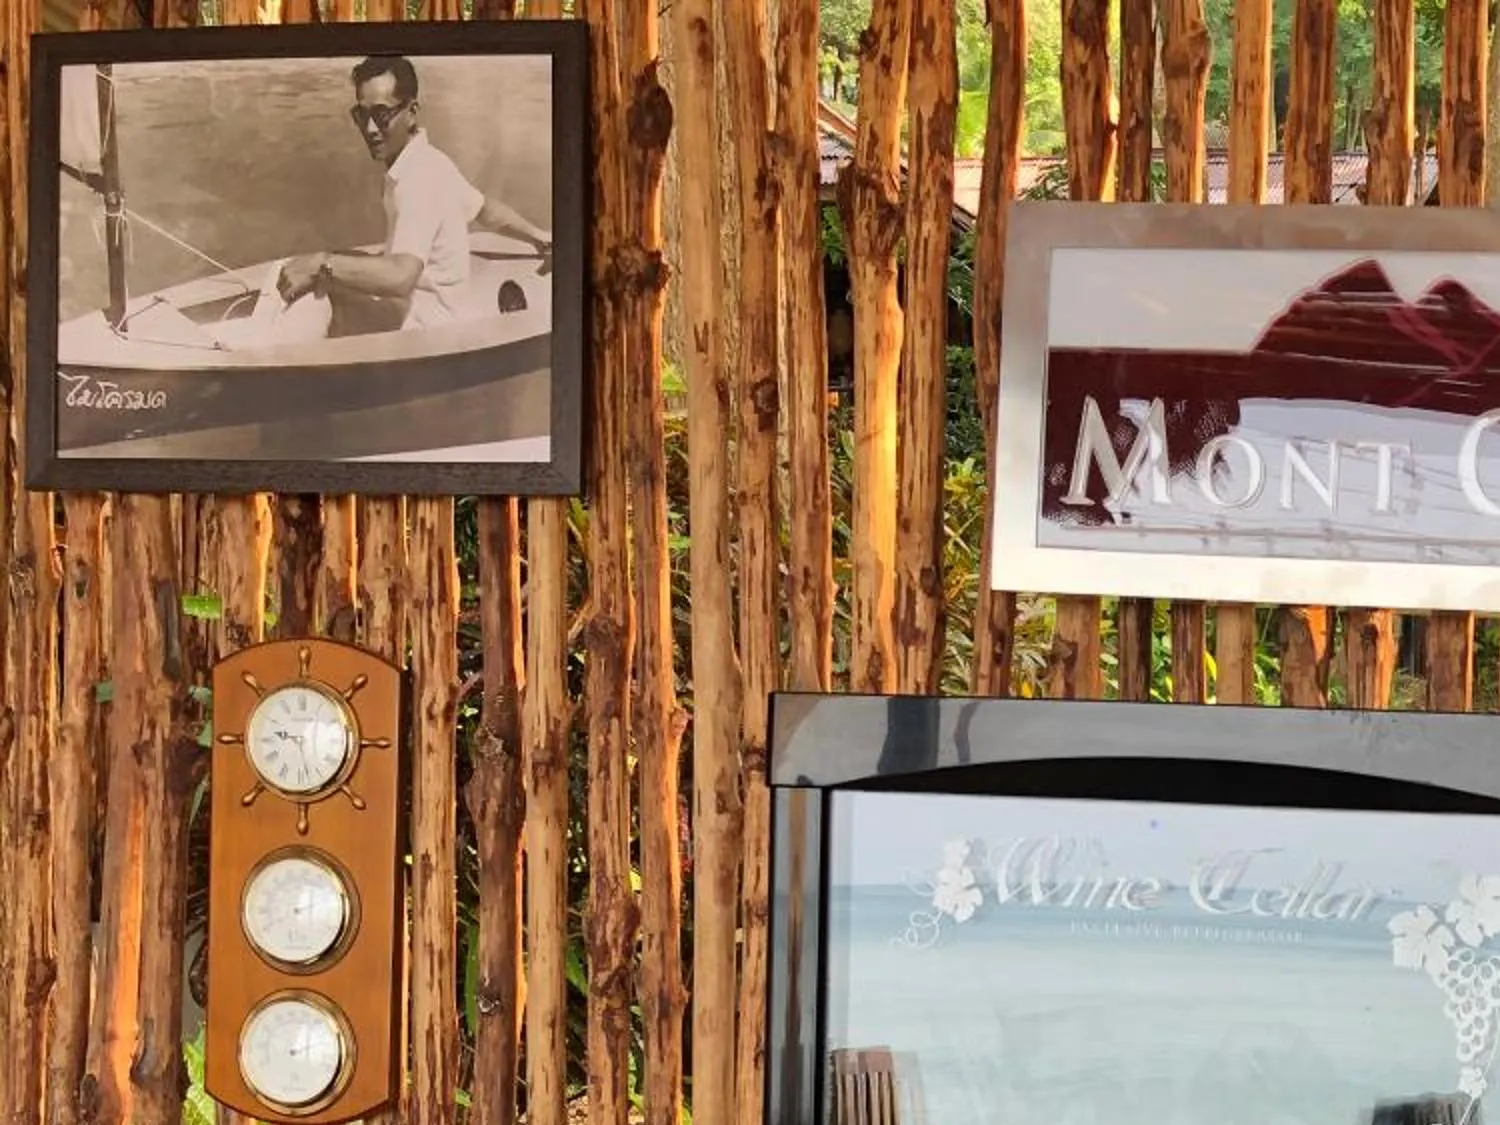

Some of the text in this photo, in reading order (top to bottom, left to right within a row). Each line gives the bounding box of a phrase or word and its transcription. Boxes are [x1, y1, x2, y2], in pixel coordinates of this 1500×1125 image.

[1058, 395, 1413, 518] MONT
[988, 834, 1390, 922] Wine Cellar
